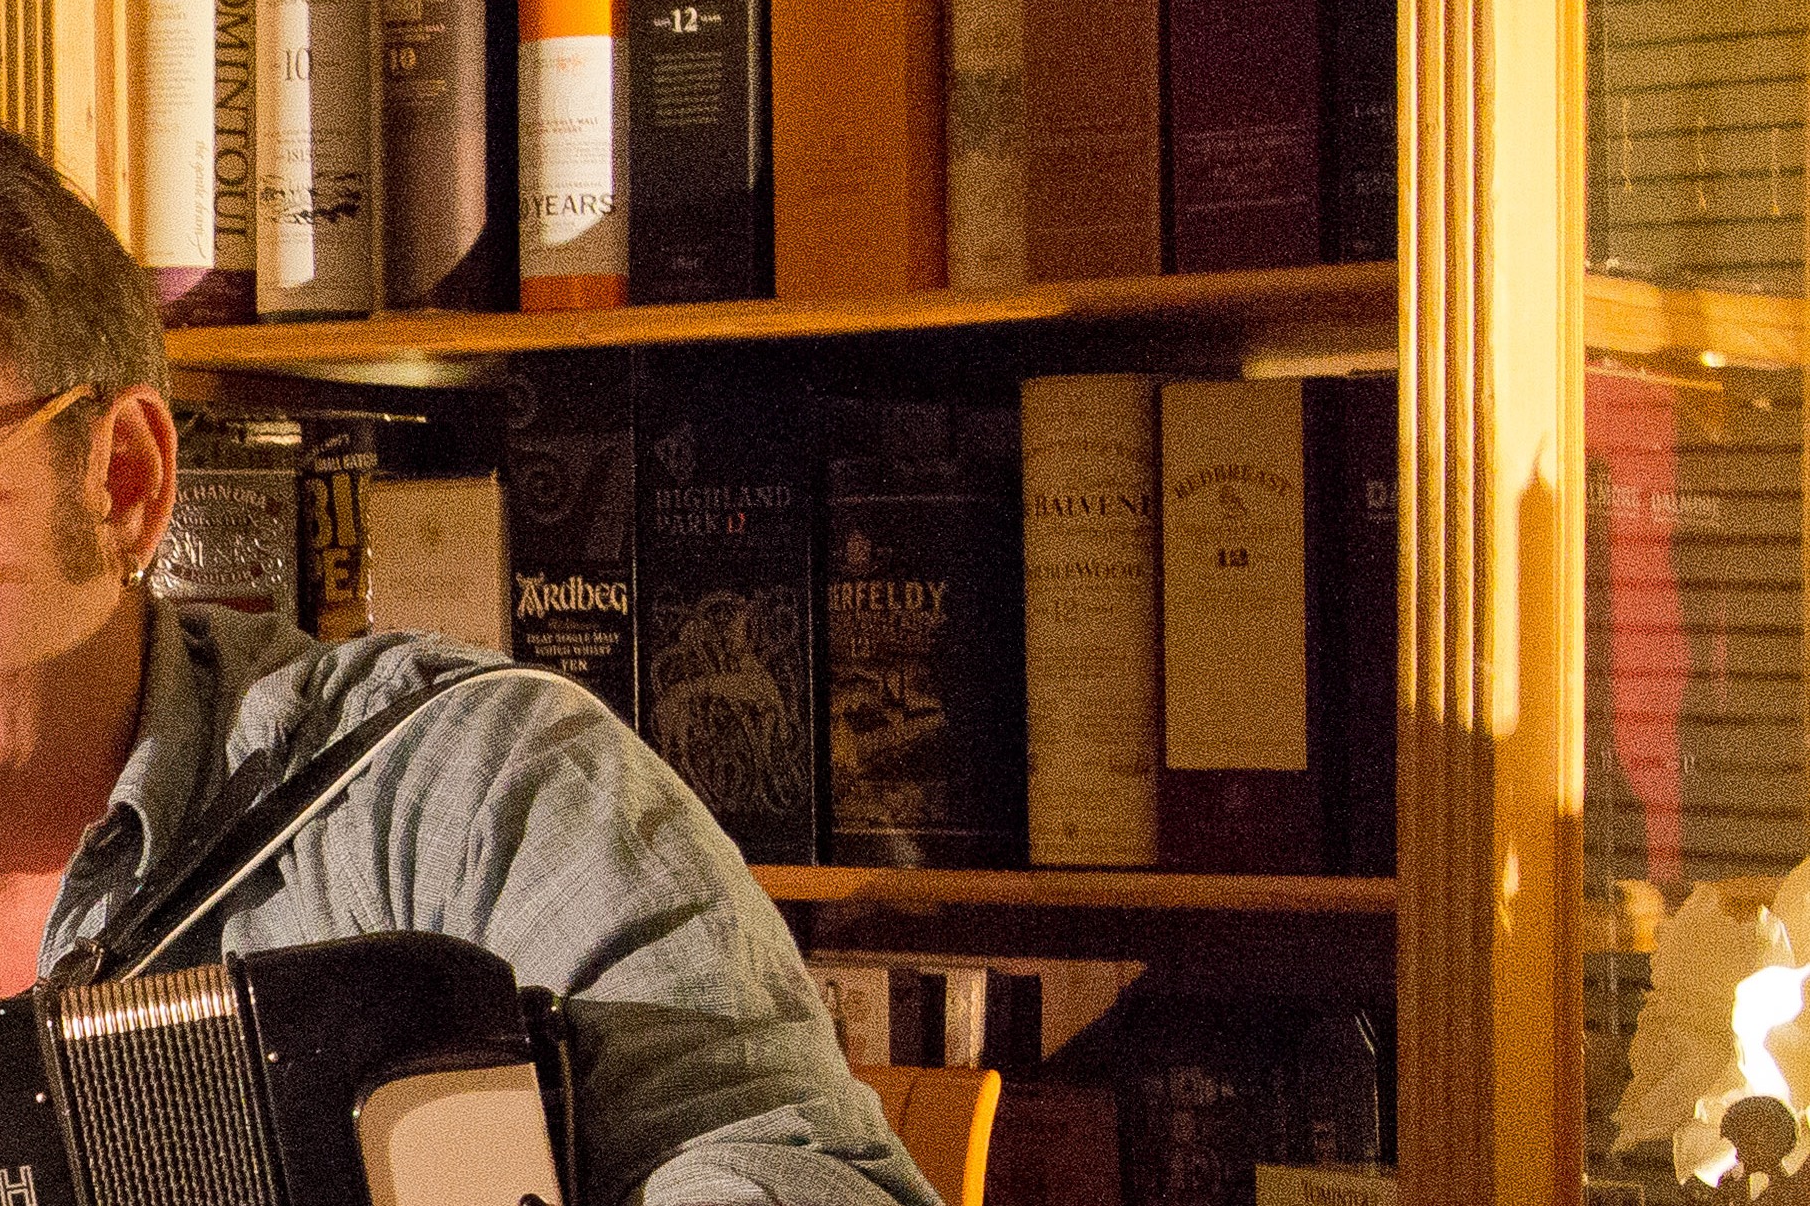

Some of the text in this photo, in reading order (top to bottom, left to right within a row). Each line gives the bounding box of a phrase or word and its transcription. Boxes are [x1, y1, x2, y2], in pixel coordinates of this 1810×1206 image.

[670, 7, 698, 33] 12
[285, 48, 312, 82] 10
[214, 0, 249, 252] MINTOUL
[532, 192, 617, 218] YEARS
[1173, 465, 1293, 499] REDBREAST
[655, 486, 792, 509] HIGHLAND
[656, 511, 748, 536] PARK 12
[1217, 547, 1249, 568] 12
[561, 658, 588, 672] TEN
